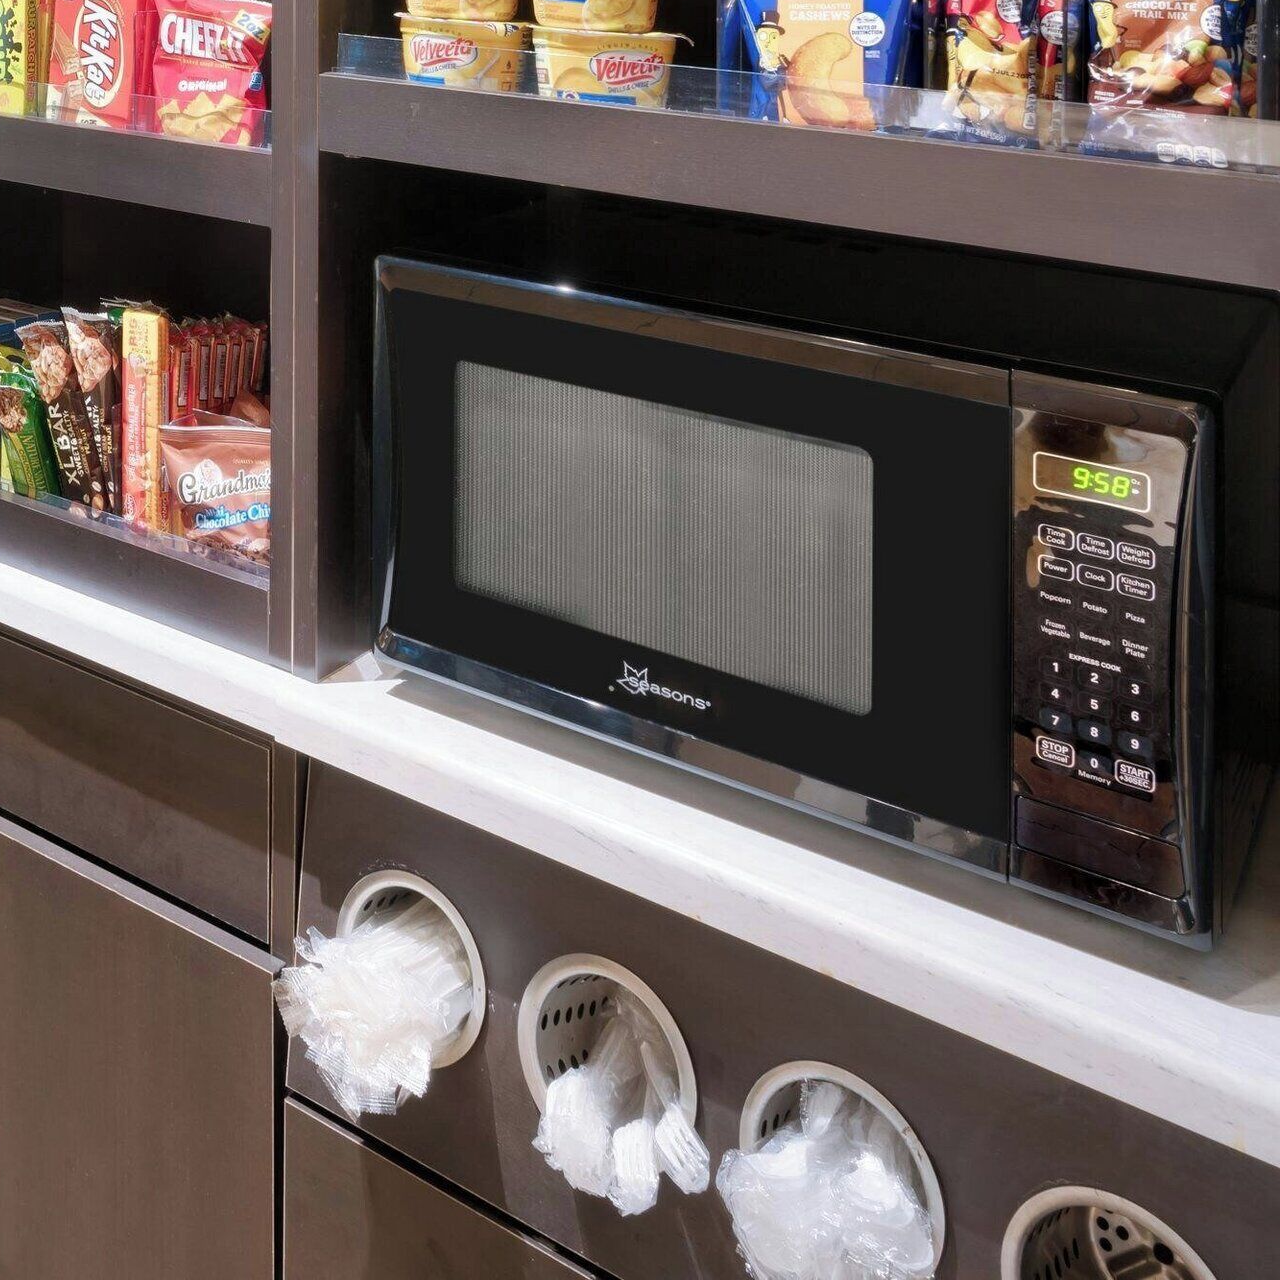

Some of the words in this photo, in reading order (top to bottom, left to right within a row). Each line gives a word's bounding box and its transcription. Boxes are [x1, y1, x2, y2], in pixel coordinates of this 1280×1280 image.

[1124, 0, 1198, 11] CHOCOLATE
[789, 10, 851, 22] CASHEWS
[1133, 10, 1166, 20] TRAIL
[1167, 11, 1190, 21] MIX
[411, 37, 477, 68] Velveeta
[594, 52, 666, 86] Velveeta
[47, 402, 72, 451] BAR
[1073, 467, 1130, 498] 9:58
[1046, 527, 1066, 539] Time
[1046, 535, 1066, 546] Cook
[1085, 536, 1106, 548] Time
[1081, 543, 1110, 557] Defrost
[1121, 545, 1150, 558] Weight
[1121, 552, 1150, 566] Defrost
[1043, 561, 1068, 573] Power
[1084, 570, 1106, 583] Clock
[1120, 576, 1150, 590] Kitchen
[1124, 584, 1148, 596] Timer
[1040, 590, 1072, 605] Popcorn
[1082, 601, 1108, 614] Potato
[1045, 618, 1066, 630] Frozen
[1125, 612, 1146, 624] Pizza
[1040, 624, 1071, 639] Vegetable
[1079, 631, 1111, 647] Beverage
[1121, 638, 1149, 652] Dinner
[1125, 647, 1146, 659] Plate
[1052, 662, 1059, 673] 1
[1068, 653, 1100, 667] EXPRESS
[1100, 660, 1121, 672] COOK
[1090, 672, 1099, 684] 2
[629, 675, 707, 710] seasons
[1051, 688, 1060, 699] 4
[1130, 683, 1140, 695] 3
[1090, 699, 1099, 710] 5
[1051, 714, 1060, 726] 7
[1130, 710, 1140, 722] 6
[1090, 726, 1099, 738] 8
[1041, 739, 1069, 754] STOP
[1130, 738, 1140, 750] 9
[1042, 750, 1069, 764] Cancel
[1090, 757, 1099, 769] 0
[1119, 763, 1151, 779] START
[1077, 769, 1112, 786] Memory
